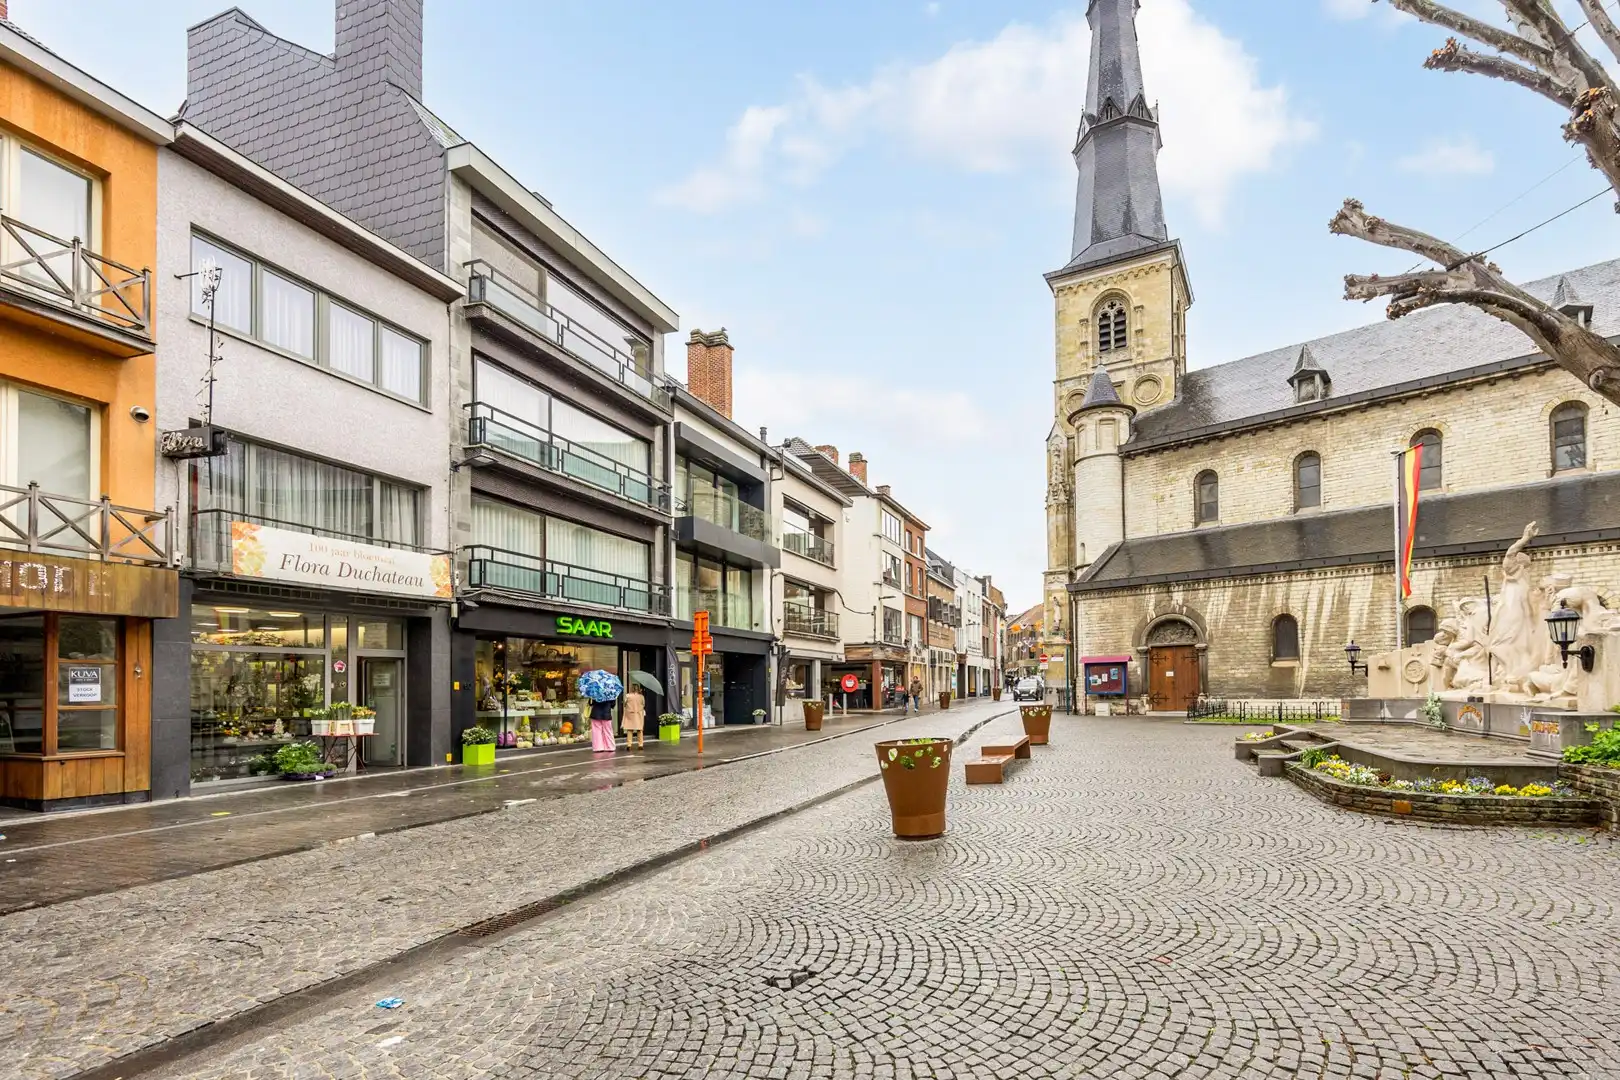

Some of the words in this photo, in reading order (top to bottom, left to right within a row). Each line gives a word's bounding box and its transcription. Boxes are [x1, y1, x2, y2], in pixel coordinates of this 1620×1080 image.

[279, 553, 331, 576] Flora
[337, 561, 425, 588] Duchateau
[556, 616, 613, 638] SAAR
[71, 670, 98, 679] KUVA
